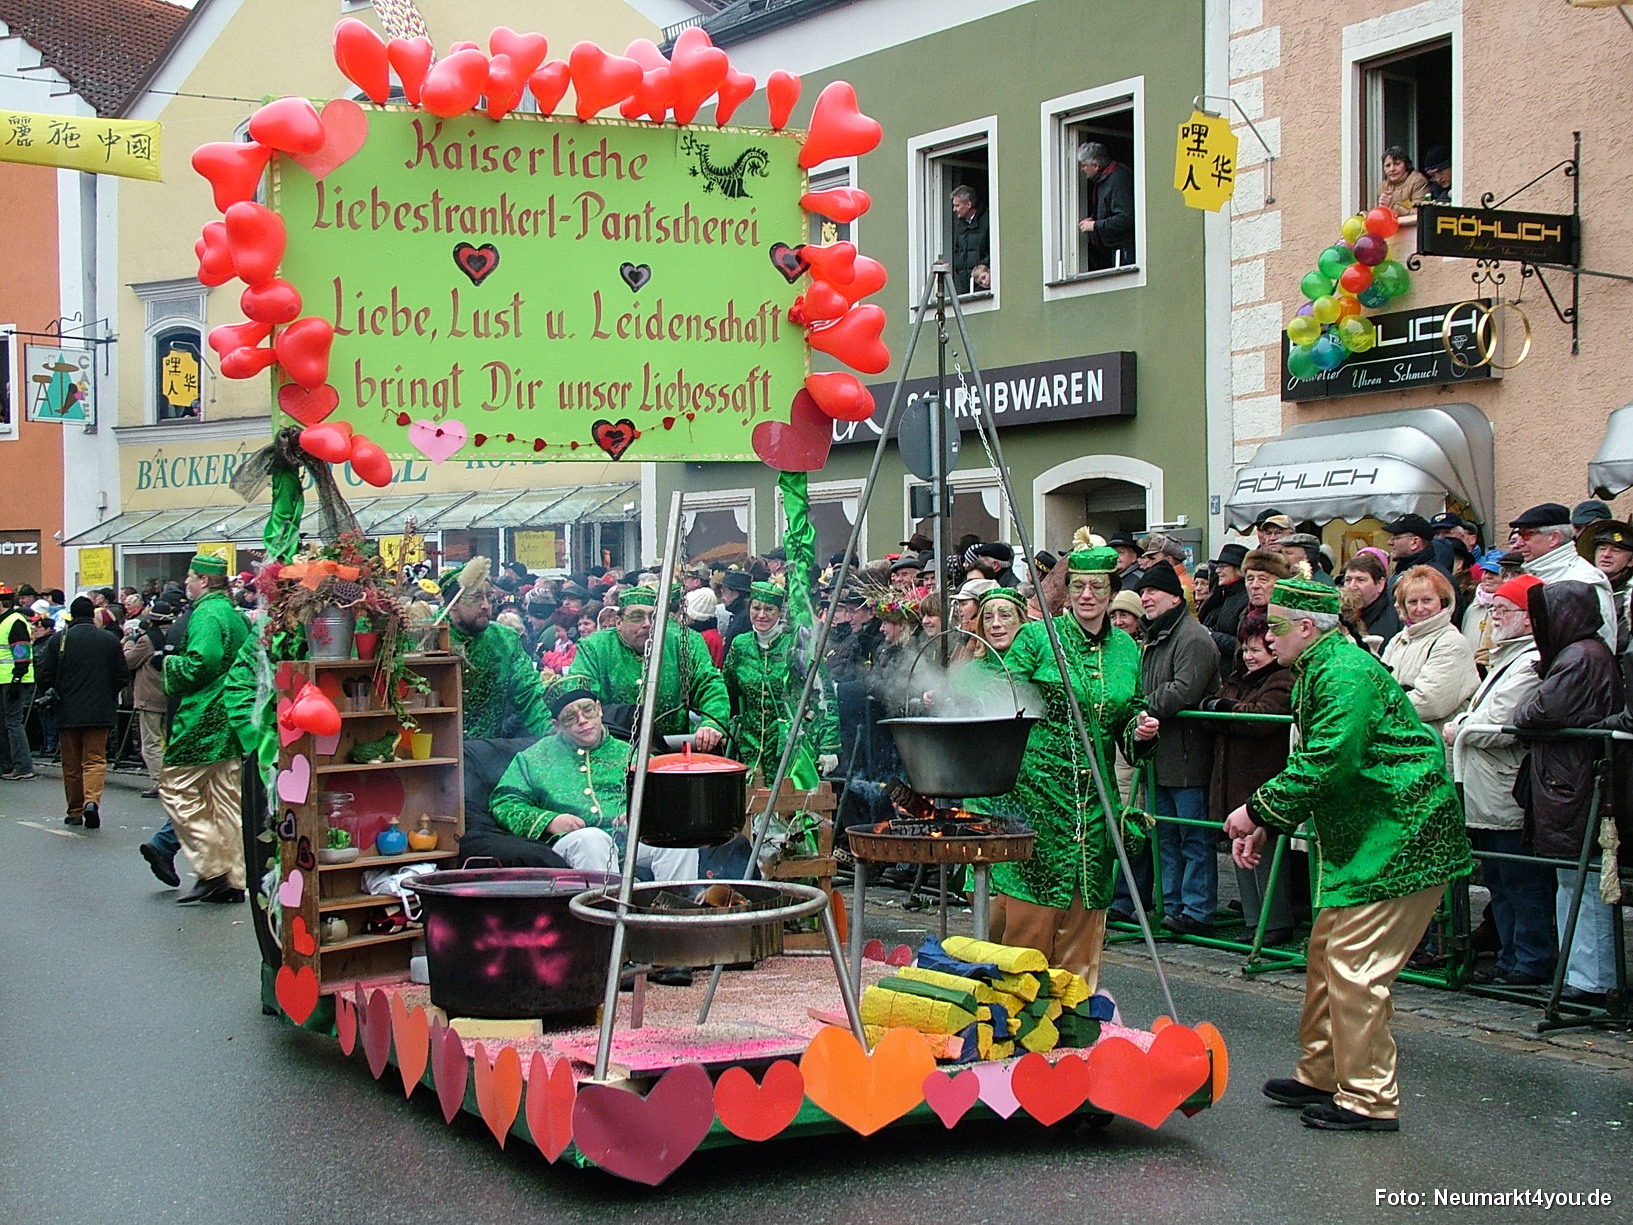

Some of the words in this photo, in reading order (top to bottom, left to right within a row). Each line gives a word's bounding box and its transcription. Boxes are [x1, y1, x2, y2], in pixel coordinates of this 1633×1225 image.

[405, 118, 648, 181] Kaiserliche
[311, 179, 761, 247] Liebestrankerl-Pantscherei
[1436, 214, 1562, 243] RÖHLICH
[333, 276, 438, 344] Liebe,
[447, 287, 526, 340] Lust
[545, 309, 577, 341] u.
[591, 289, 783, 350] Leidenschaft
[353, 357, 465, 422] bringt
[479, 360, 544, 412] Dir
[558, 377, 633, 409] unser
[637, 361, 773, 426] Liebessaft
[1351, 368, 1383, 389] Uhren
[1388, 359, 1439, 384] Schmuck
[1234, 467, 1379, 496] RÖHLICH
[0, 541, 38, 555] ÖTZ
